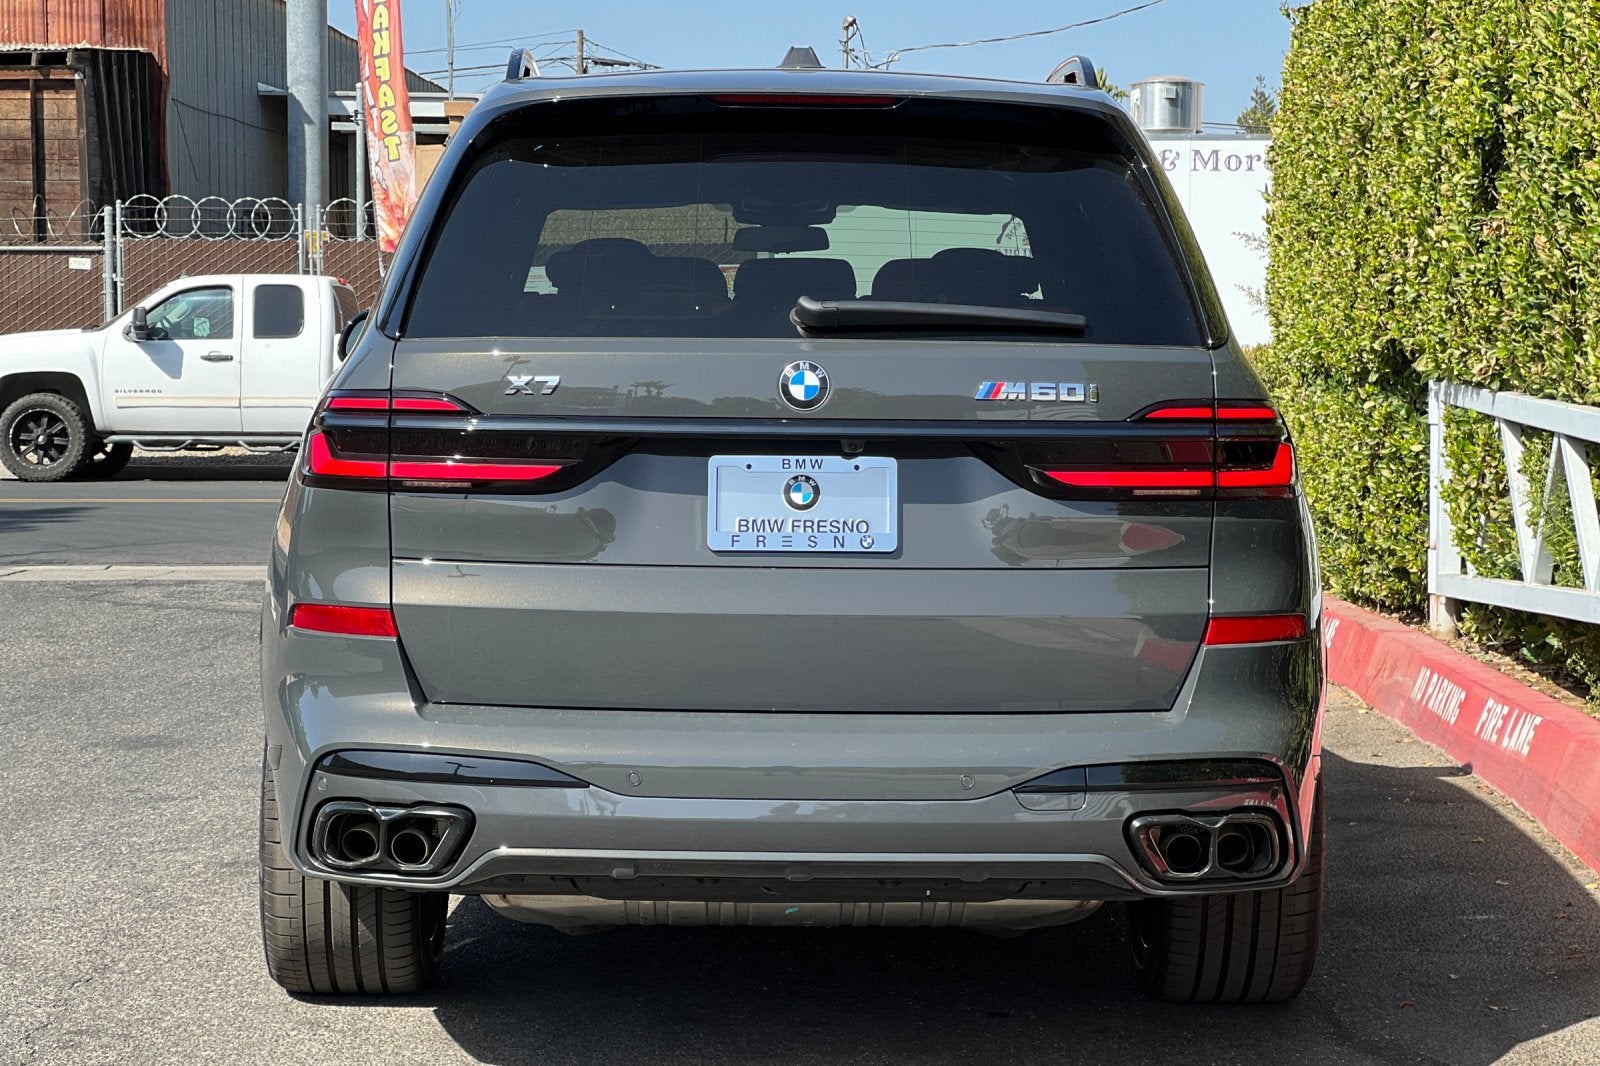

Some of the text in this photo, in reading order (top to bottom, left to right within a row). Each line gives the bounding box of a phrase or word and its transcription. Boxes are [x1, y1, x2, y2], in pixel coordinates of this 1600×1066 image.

[1159, 149, 1180, 172] &
[784, 361, 825, 378] BMW
[504, 375, 561, 396] X7
[781, 458, 824, 470] BMW
[788, 475, 817, 487] BMW
[737, 518, 870, 534] BMW FRESNO
[1410, 665, 1543, 757] NO PARKING FIRE LANE
